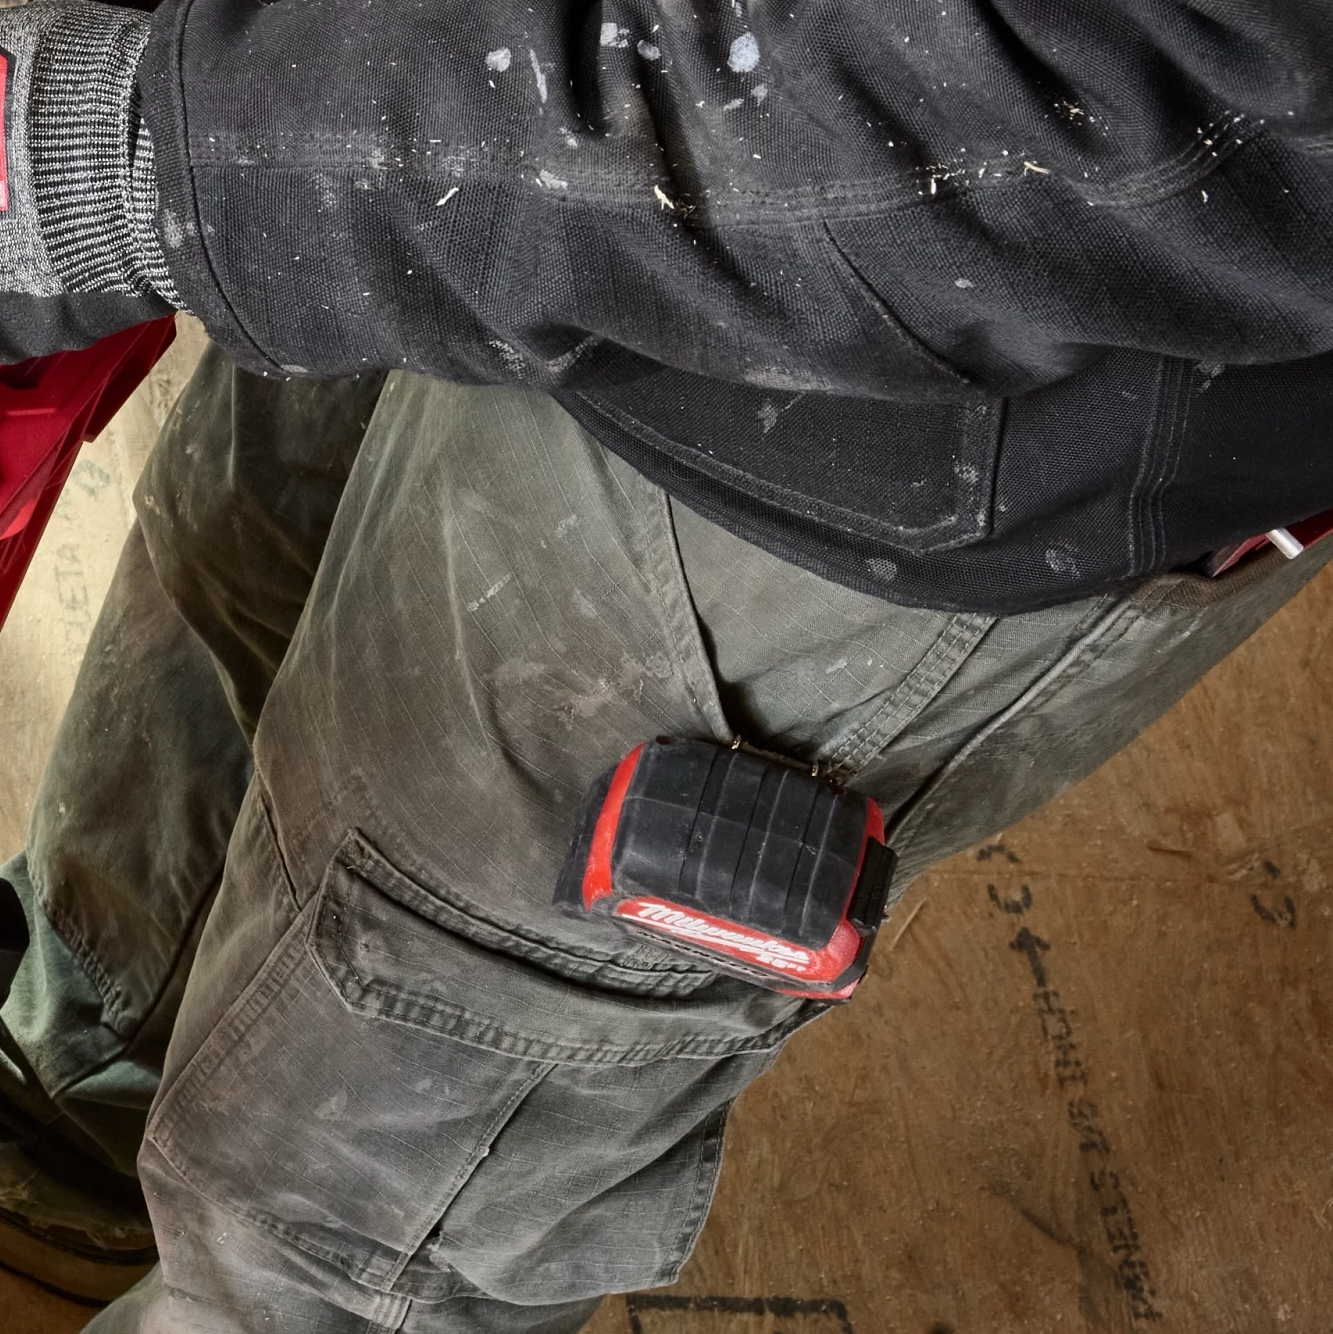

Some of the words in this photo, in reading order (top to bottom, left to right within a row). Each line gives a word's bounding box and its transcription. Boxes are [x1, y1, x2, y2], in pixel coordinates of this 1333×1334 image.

[638, 902, 811, 961] Milwaukee
[1034, 990, 1088, 1090] INCH
[1089, 1169, 1163, 1321] PANELS
